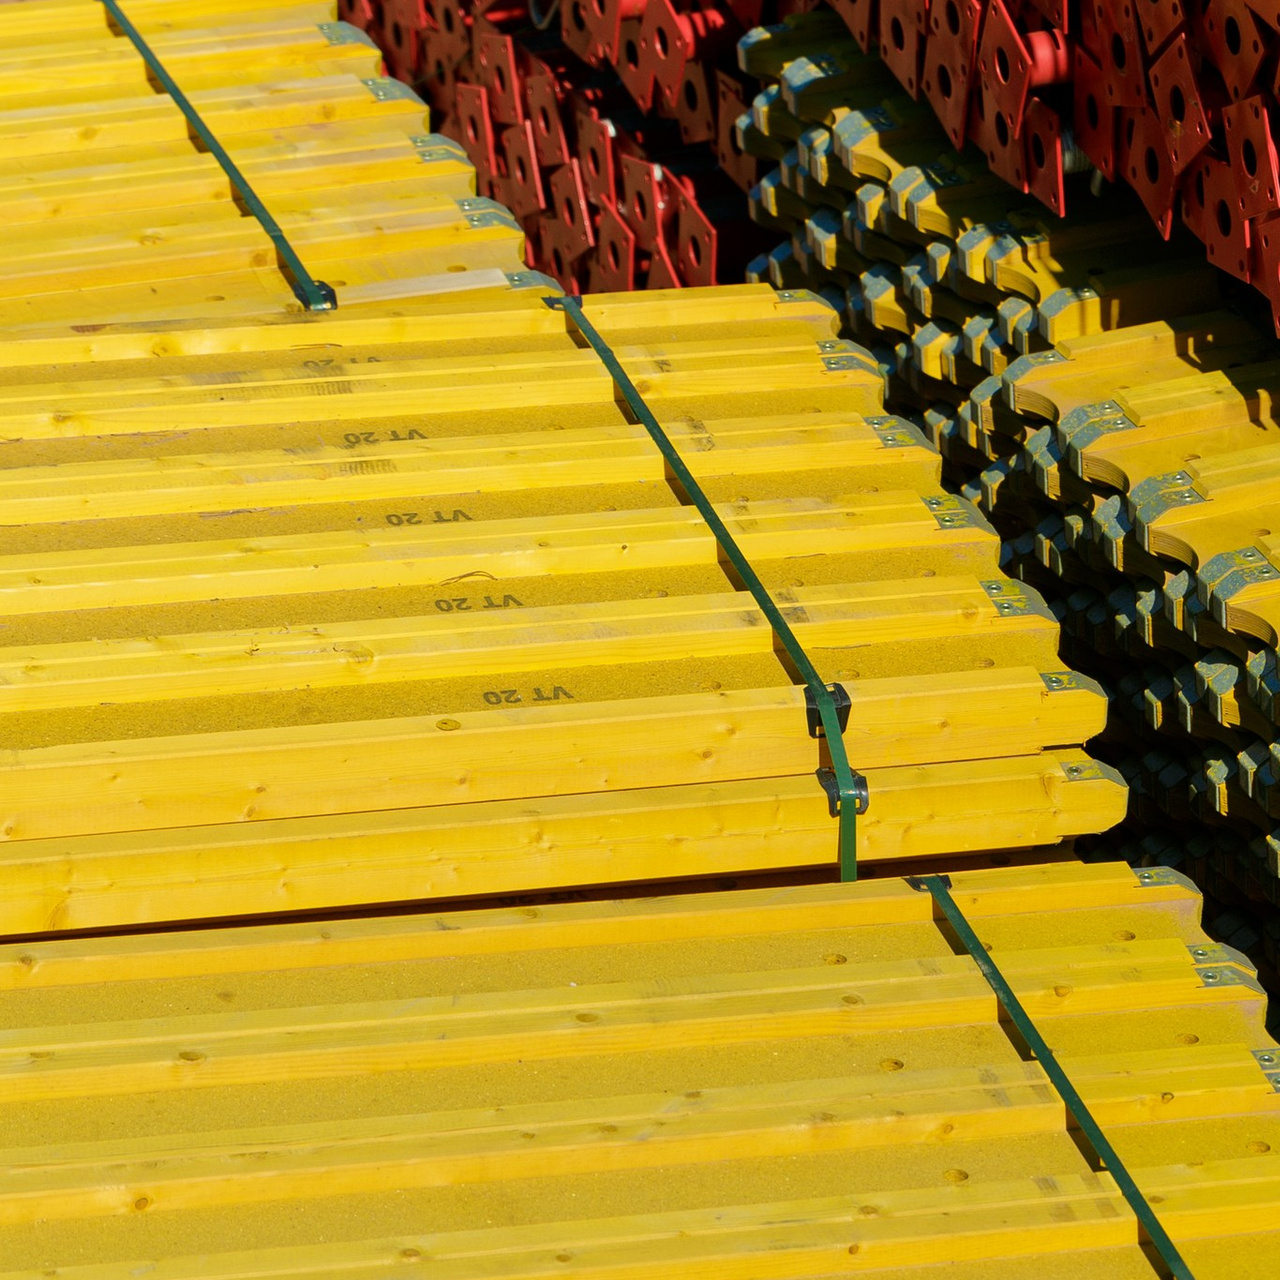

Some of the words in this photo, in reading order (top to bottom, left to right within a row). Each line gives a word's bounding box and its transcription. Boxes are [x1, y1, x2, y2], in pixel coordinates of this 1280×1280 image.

[343, 431, 380, 444] 20
[385, 513, 422, 526] 20
[433, 509, 473, 523] VT
[434, 597, 472, 612] 20
[482, 594, 523, 609] VT
[482, 689, 522, 705] 20
[532, 685, 574, 702] VT
